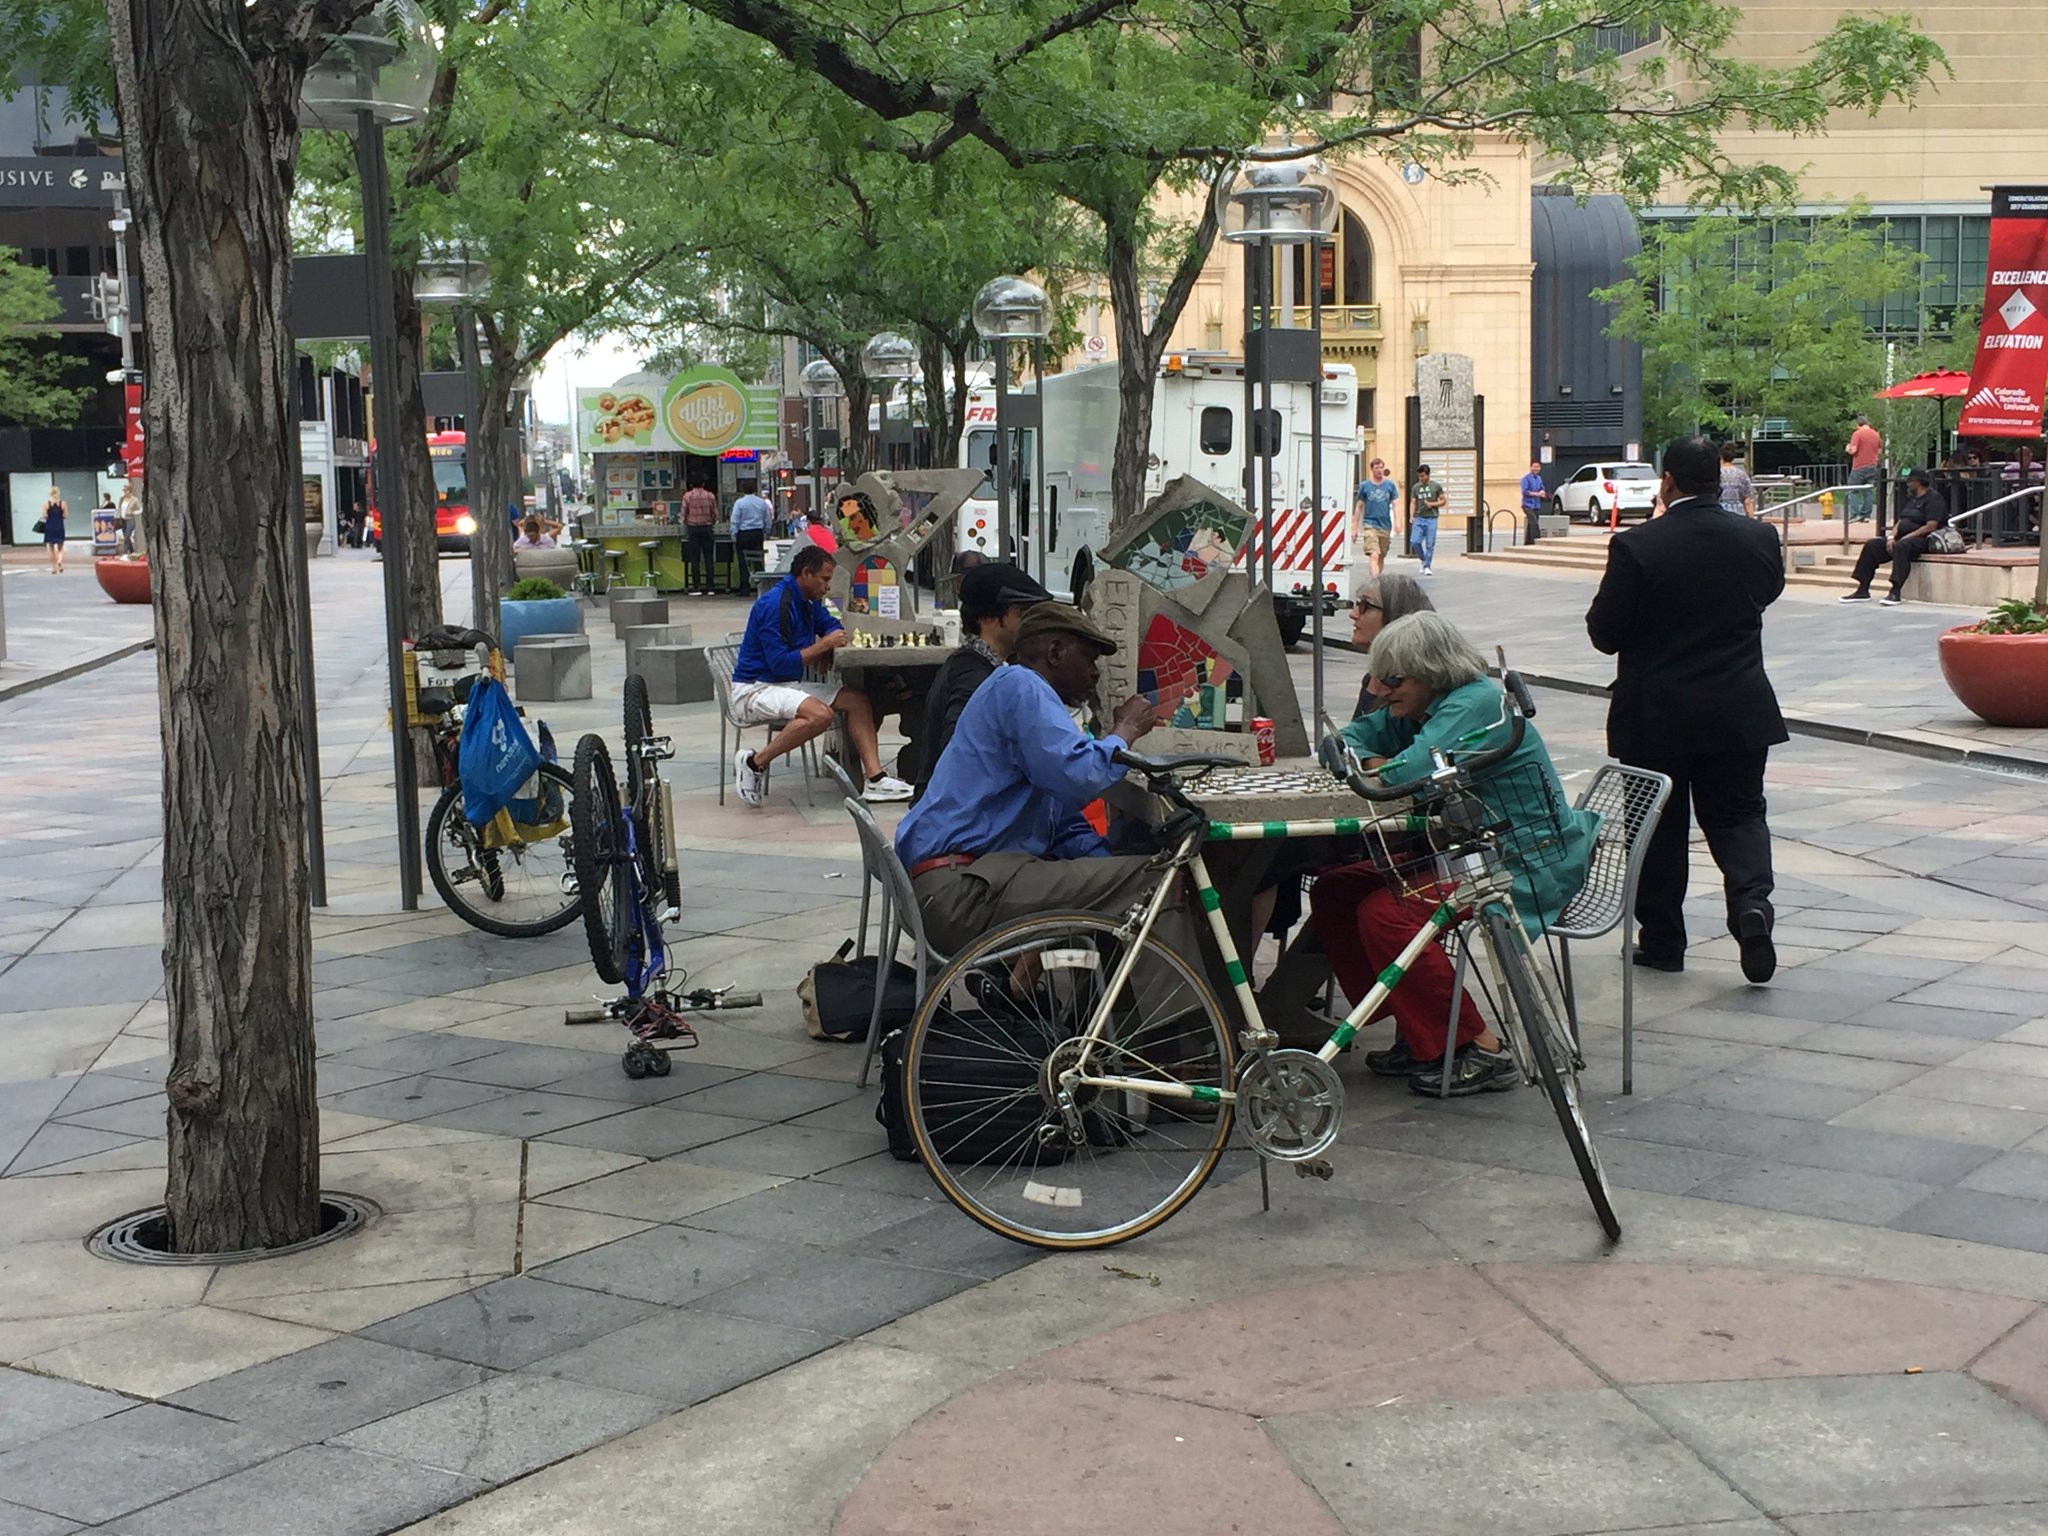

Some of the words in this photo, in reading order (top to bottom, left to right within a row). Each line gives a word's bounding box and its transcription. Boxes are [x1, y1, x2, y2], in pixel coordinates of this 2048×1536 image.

[1983, 334, 2043, 349] ELEVATION
[1994, 387, 2026, 396] Colorado
[1999, 395, 2031, 404] Technical
[679, 391, 727, 423] Wiki
[965, 407, 998, 421] FR
[2003, 402, 2041, 413] University
[697, 410, 738, 439] Pita
